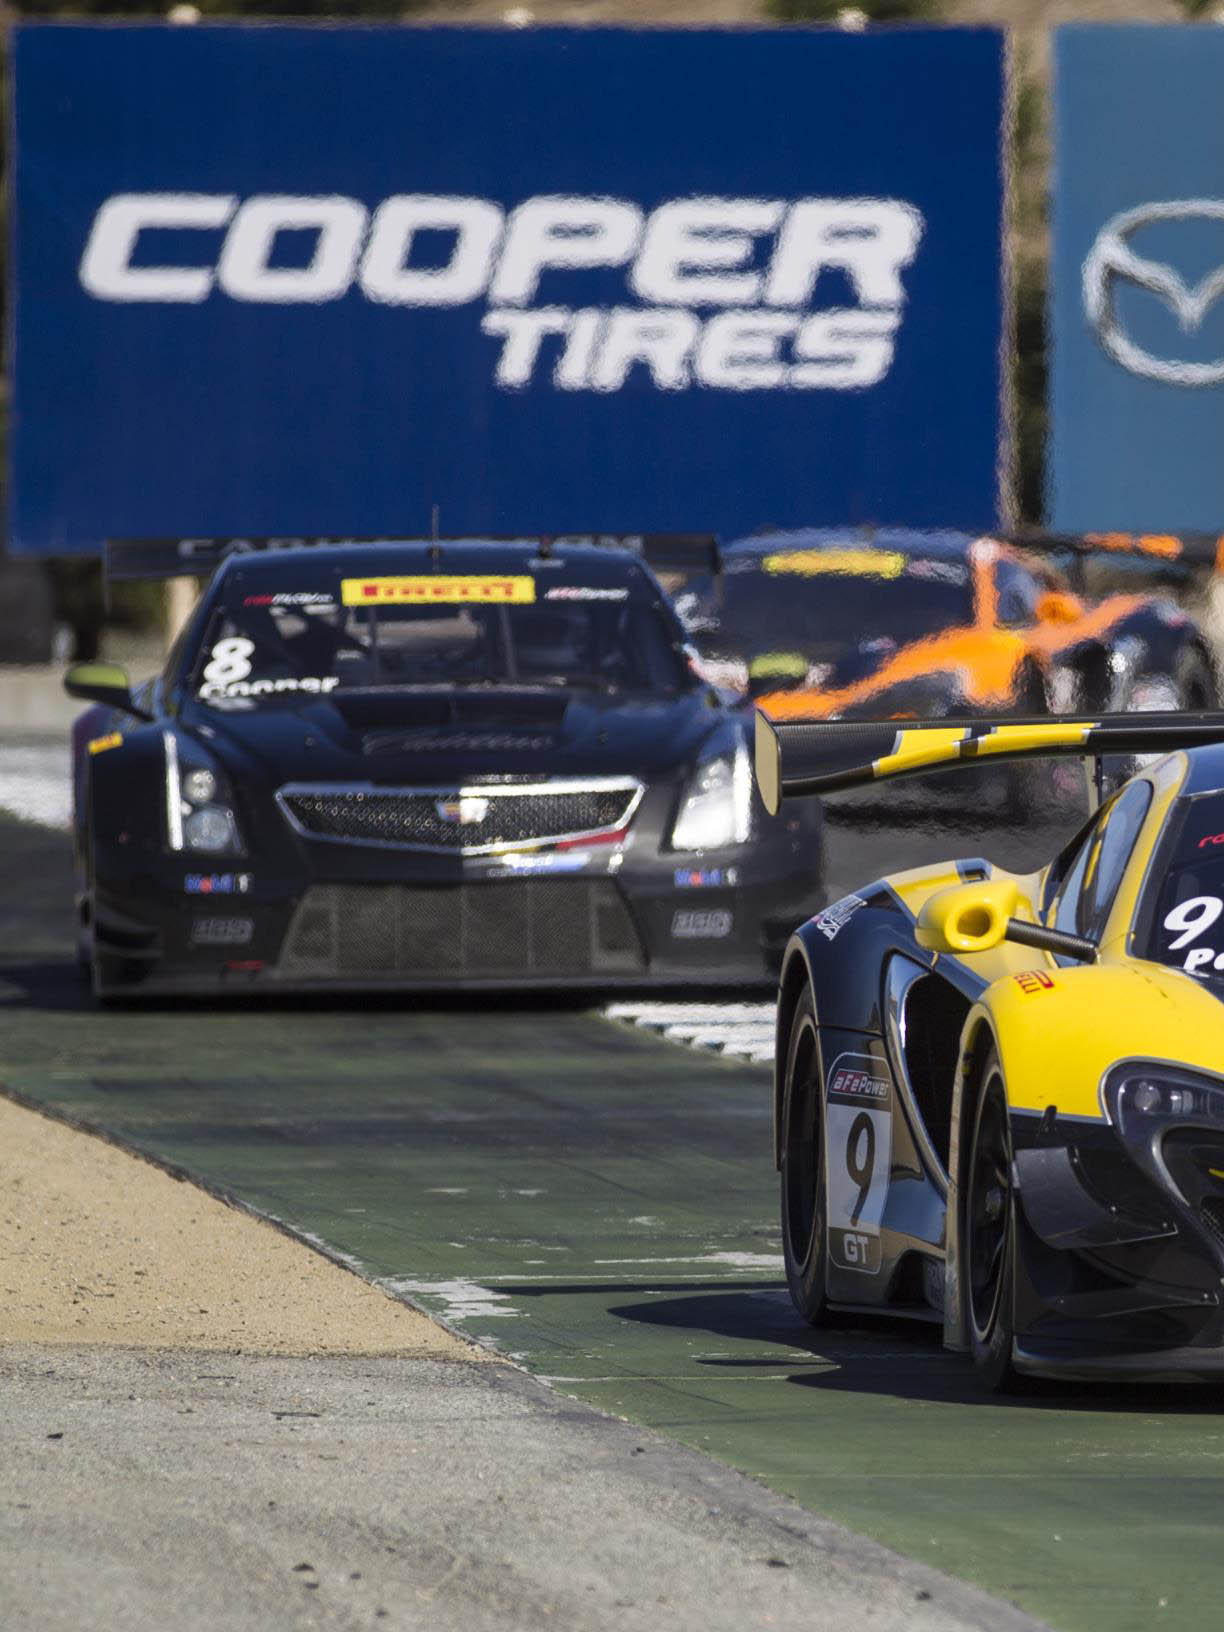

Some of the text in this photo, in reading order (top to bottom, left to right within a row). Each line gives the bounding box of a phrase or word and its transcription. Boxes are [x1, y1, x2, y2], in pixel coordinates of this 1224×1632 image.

[79, 193, 924, 308] COOPER
[481, 306, 903, 392] TIRES
[203, 637, 255, 684] 8
[1163, 896, 1224, 949] 9
[846, 1112, 875, 1226] 9
[844, 1233, 869, 1264] GT
